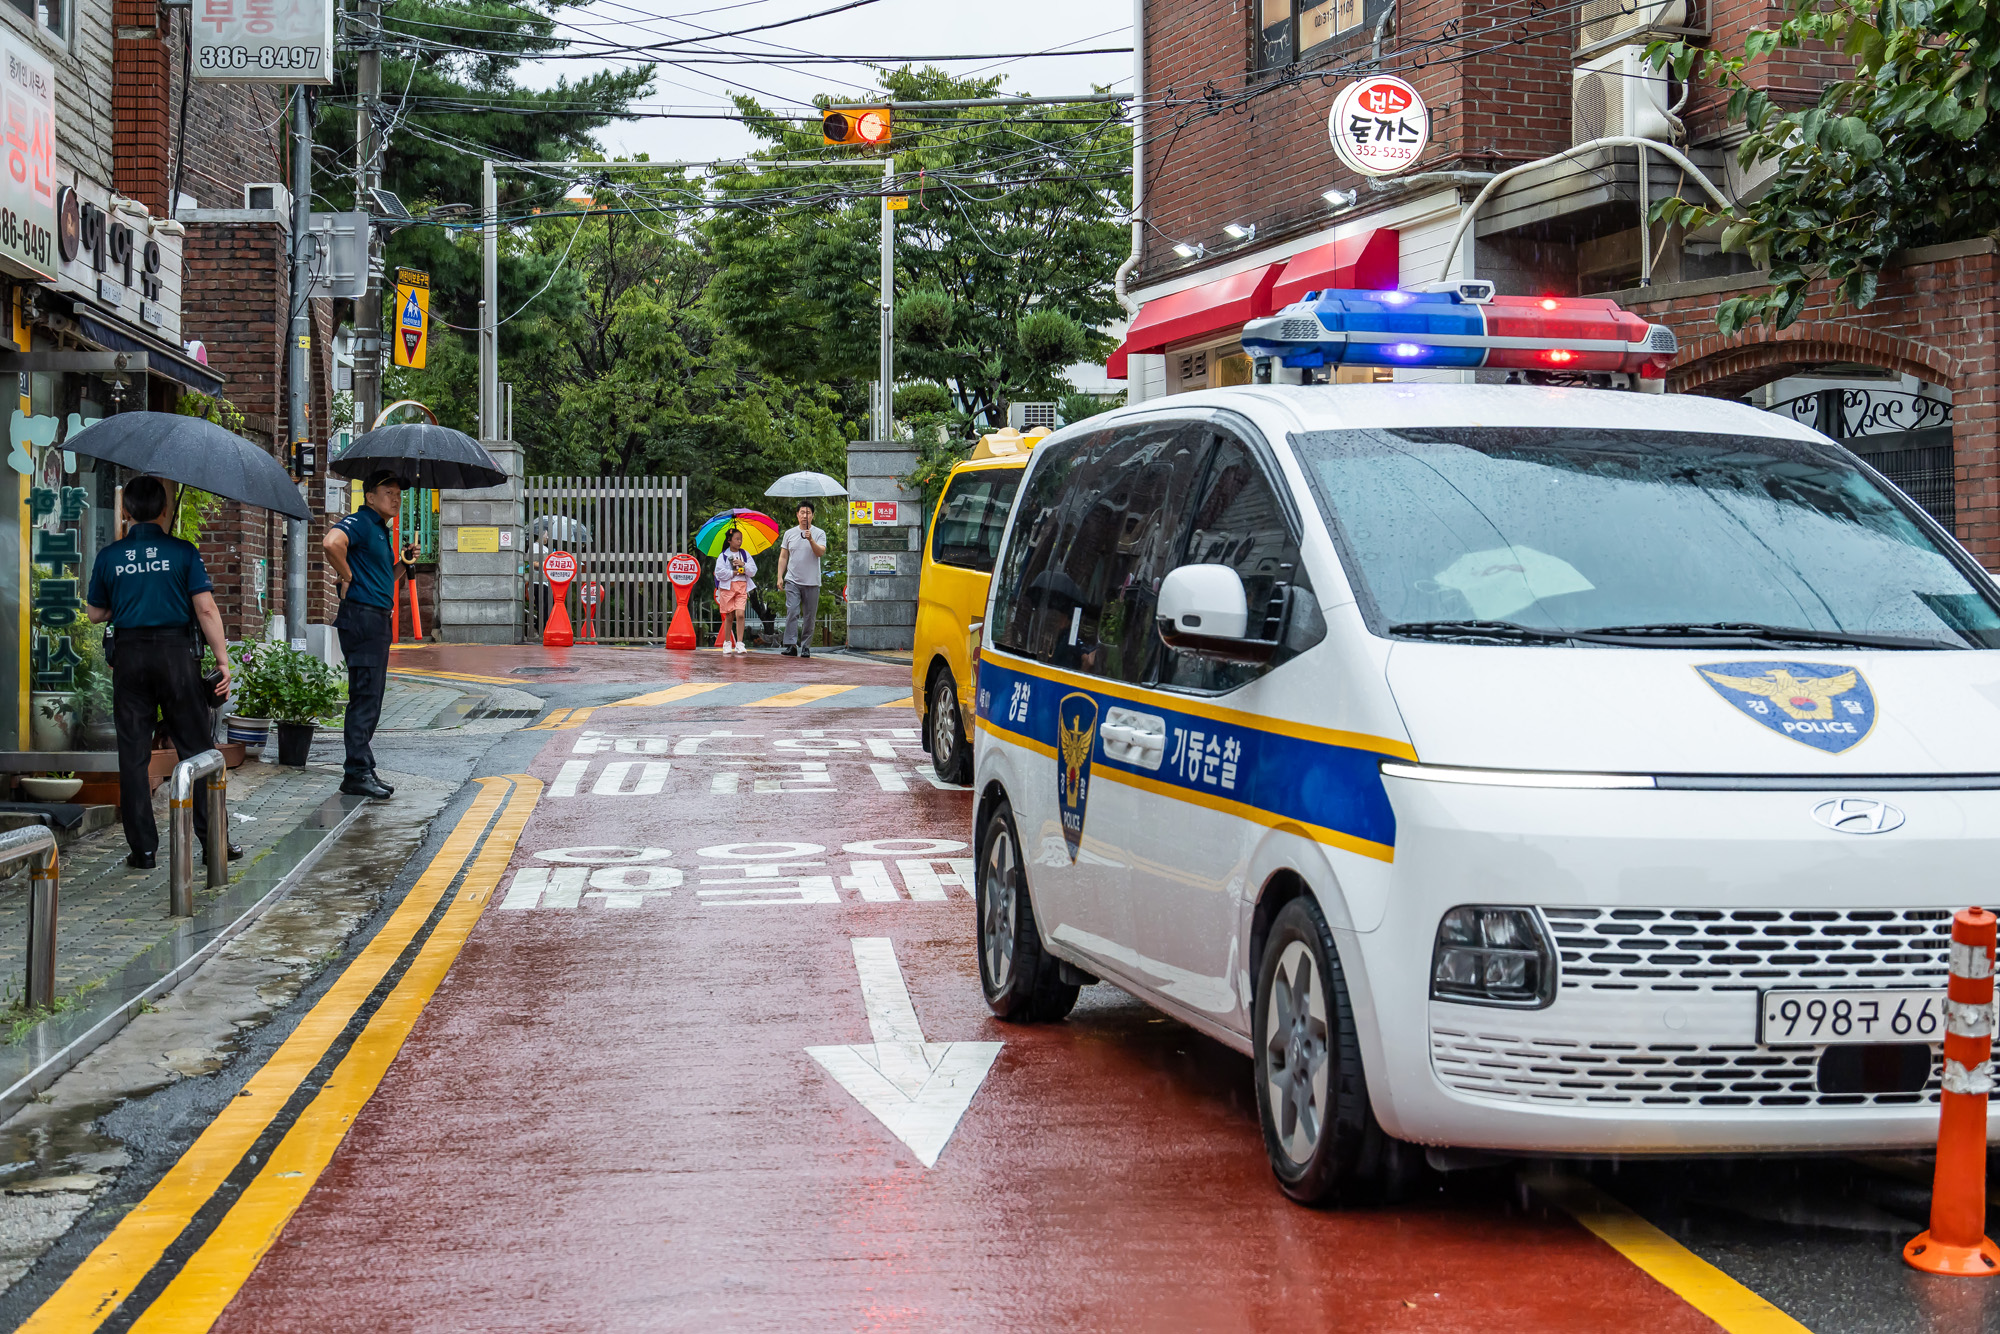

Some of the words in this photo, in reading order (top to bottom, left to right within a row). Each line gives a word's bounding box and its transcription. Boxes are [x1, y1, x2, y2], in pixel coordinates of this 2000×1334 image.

[200, 46, 320, 69] 386-8497
[29, 72, 47, 99] 사무소
[1350, 114, 1419, 143] 돈가스
[0, 103, 52, 198] 동산
[1356, 144, 1411, 159] 352-5235
[0, 206, 51, 267] 86-8497
[115, 560, 170, 576] POLICE
[549, 560, 573, 568] 주차금지
[672, 563, 695, 571] 주차금지
[1008, 681, 1031, 723] 경찰
[1782, 721, 1858, 734] POLICE
[1170, 727, 1242, 791] 기동순찰
[1063, 811, 1081, 832] POLICE
[1780, 999, 1880, 1036] 998구
[1890, 998, 1938, 1035] 66
